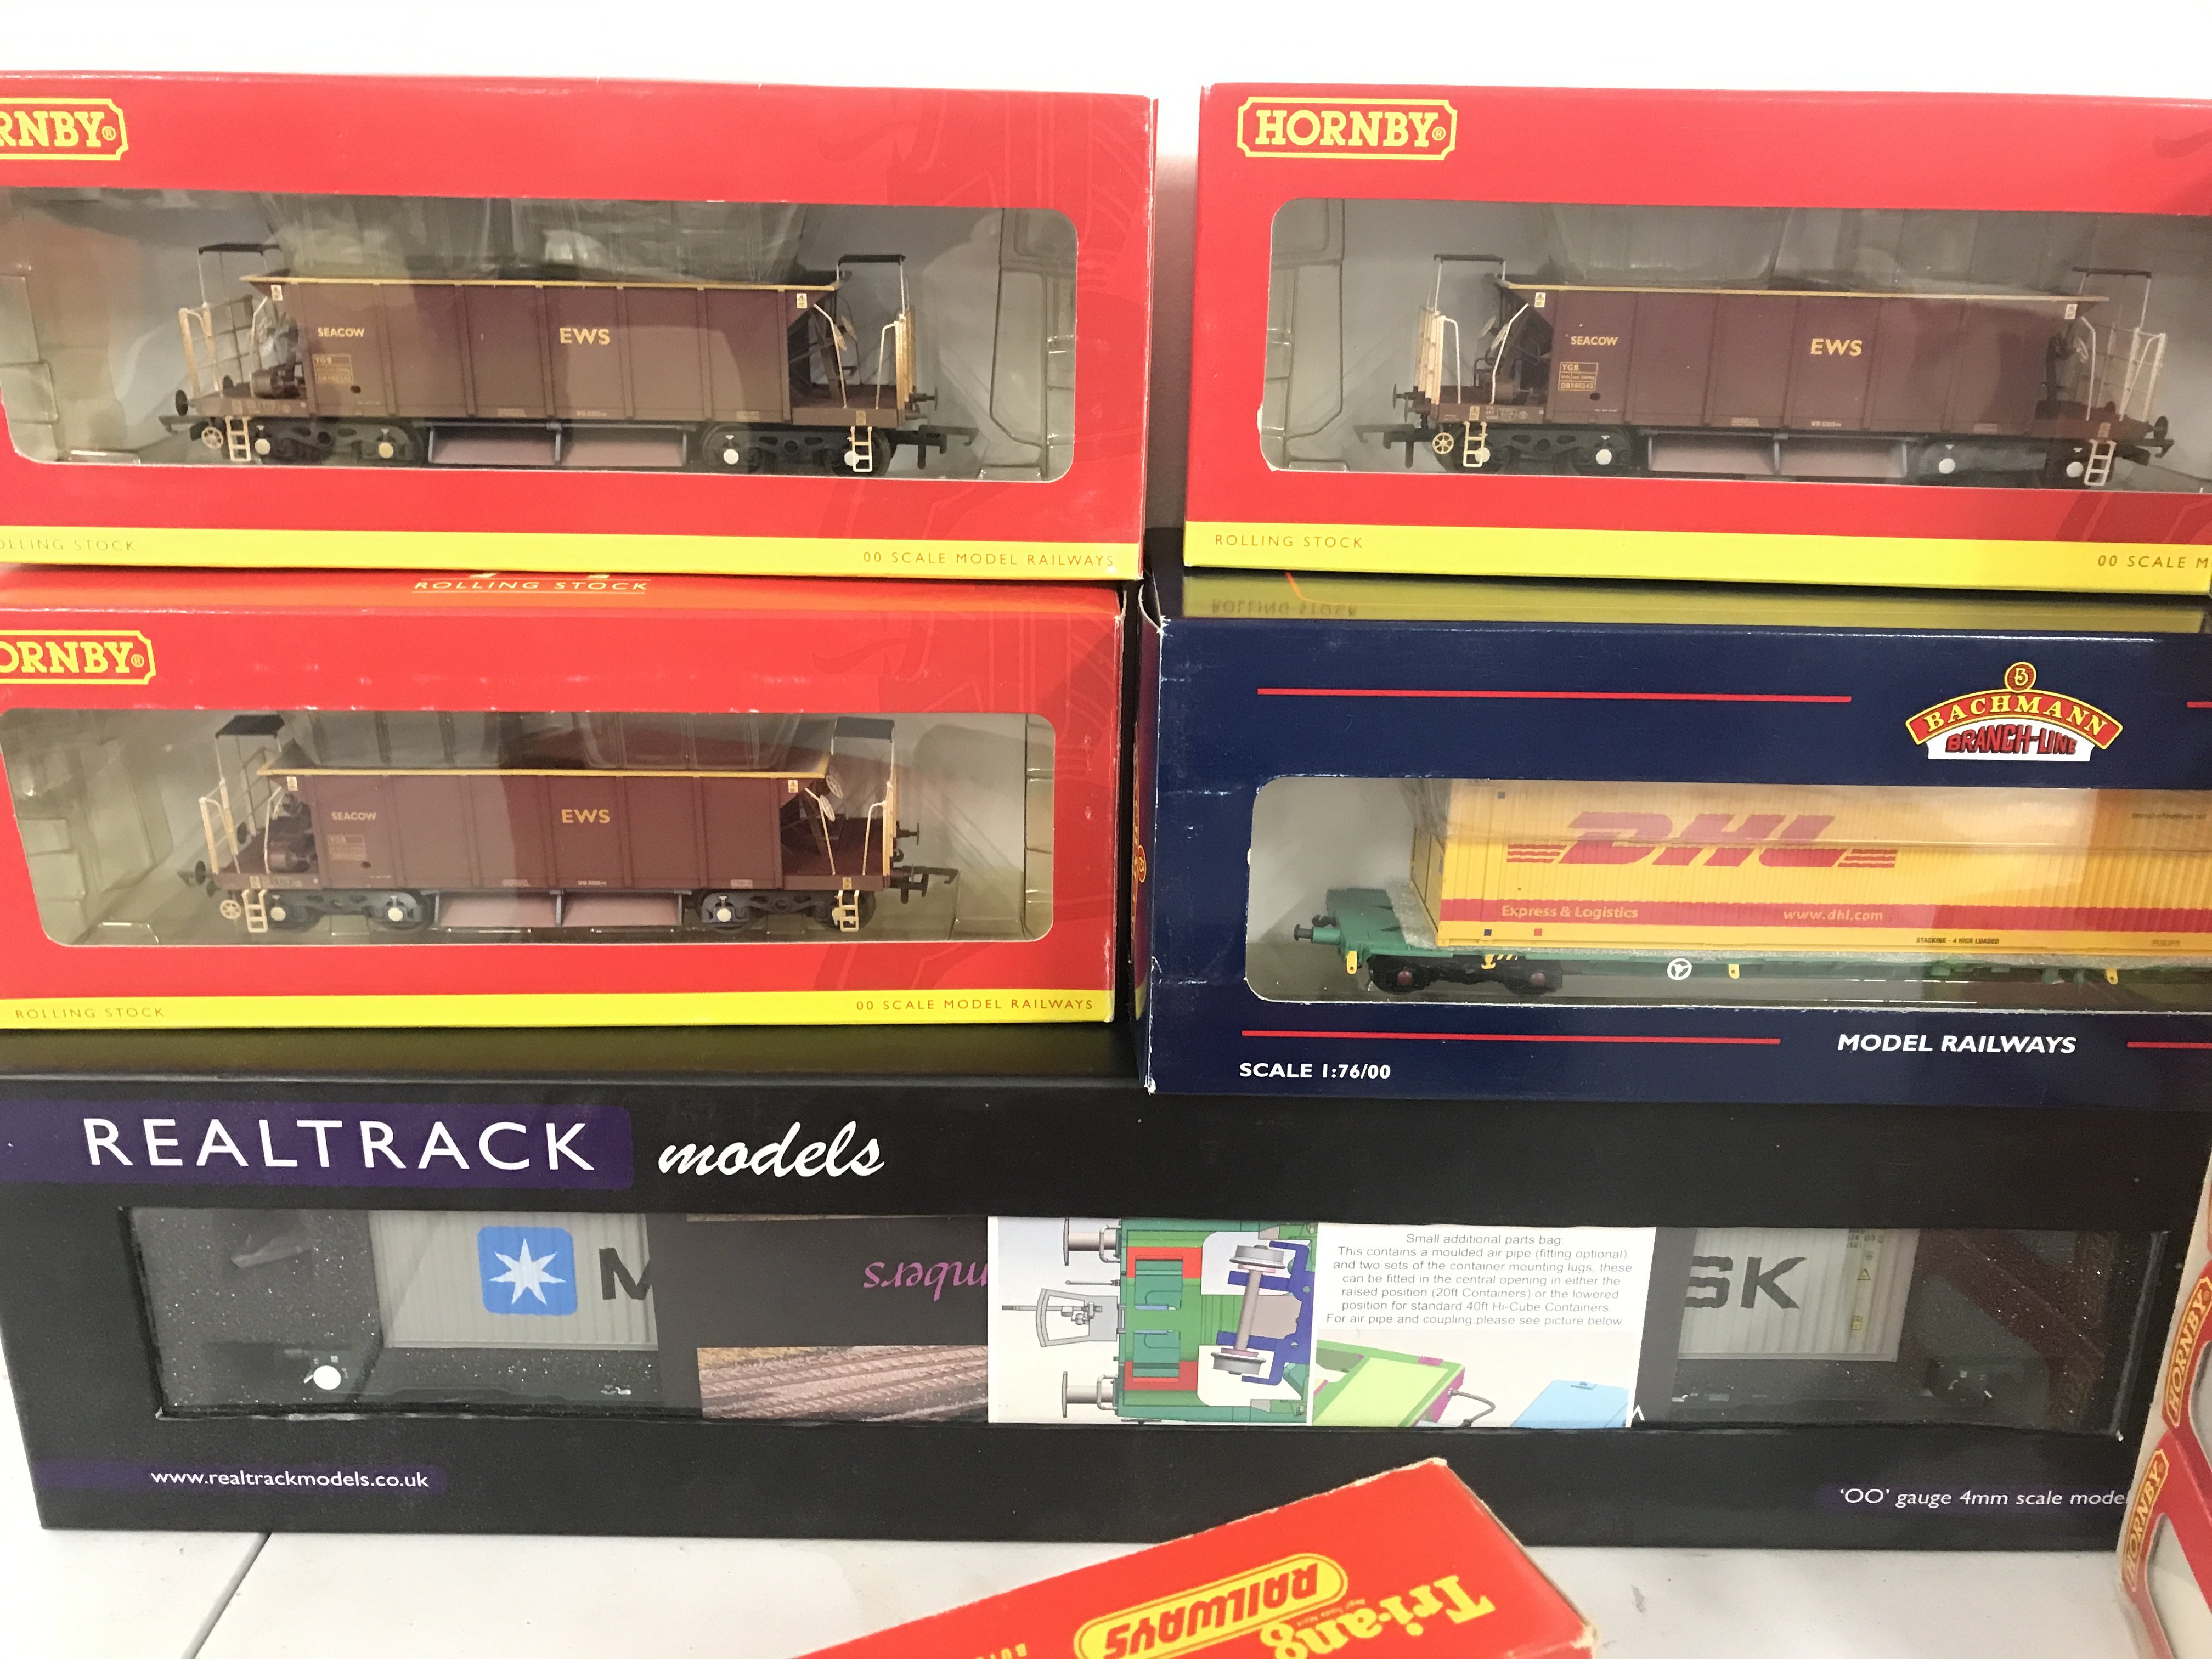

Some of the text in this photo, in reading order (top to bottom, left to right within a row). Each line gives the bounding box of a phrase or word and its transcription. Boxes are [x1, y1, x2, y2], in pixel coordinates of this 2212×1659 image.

[318, 328, 364, 337] SEACOW
[560, 328, 610, 345] EWS
[1571, 336, 1618, 345] SEACOW
[1810, 338, 1862, 356] EWS
[74, 540, 136, 551] STOCK
[1215, 534, 1362, 548] ROLLING STOCK
[891, 552, 946, 564] SCALE
[956, 553, 1017, 565] MODEL
[1028, 555, 1114, 567] RAILWAYS
[2127, 556, 2186, 568] SCALE
[1923, 695, 2108, 736] BACHMANN
[1945, 724, 2078, 755] BRANCH-LINE
[331, 812, 376, 820] SEACOW
[561, 809, 611, 823] EWS
[1558, 811, 1848, 867] DHL
[1502, 905, 1639, 920] Express & Logistics
[1784, 909, 1883, 921] www.dhl.com
[883, 1000, 934, 1010] SCALE
[944, 1000, 1002, 1009] MODEL
[1012, 999, 1093, 1009] RAILWAYS
[15, 1008, 165, 1019] ROLLING STOCK
[1837, 1034, 2077, 1053] MODEL RAILWAYS
[1240, 1063, 1391, 1079] SCALE 1:76/00
[83, 1118, 885, 1177] REALTRACK models
[1407, 1234, 1439, 1243] Small
[1443, 1234, 1501, 1244] additional
[1505, 1236, 1534, 1245] parts
[1339, 1246, 1362, 1256] This
[1367, 1248, 1417, 1256] contains
[1432, 1248, 1483, 1257] moulded
[1487, 1249, 1502, 1257] air
[1506, 1249, 1531, 1259] pipe
[1536, 1249, 1571, 1260] (fitting
[1576, 1250, 1628, 1260] optional)
[1333, 1261, 1355, 1269] and
[1360, 1261, 1380, 1269] two
[1385, 1261, 1408, 1269] sets
[1412, 1261, 1424, 1270] of
[1427, 1261, 1446, 1270] the
[1450, 1262, 1505, 1271] container
[1509, 1263, 1564, 1274] mounting
[1600, 1263, 1633, 1272] these
[1368, 1274, 1383, 1283] be
[1387, 1274, 1415, 1283] fitted
[1420, 1274, 1429, 1283] in
[1434, 1274, 1452, 1284] the
[1455, 1275, 1496, 1284] central
[1499, 1276, 1547, 1287] opening
[1551, 1277, 1561, 1285] in
[1565, 1276, 1599, 1285] either
[1602, 1277, 1621, 1285] the
[1342, 1287, 1378, 1296] raised
[1381, 1288, 1427, 1299] position
[1432, 1288, 1458, 1299] (20ft
[1463, 1288, 1531, 1300] Containers)
[1550, 1290, 1568, 1299] the
[1573, 1290, 1619, 1299] lowered
[1342, 1301, 1387, 1311] position
[1391, 1301, 1407, 1310] for
[1411, 1301, 1462, 1311] standard
[1466, 1302, 1488, 1311] 40ft
[1493, 1302, 1541, 1312] Hi-Cube
[1327, 1314, 1346, 1323] For
[1350, 1315, 1364, 1323] air
[1369, 1315, 1393, 1325] pipe
[1397, 1315, 1419, 1324] and
[1519, 1317, 1541, 1325] see
[1544, 1317, 1584, 1327] picture
[151, 1470, 430, 1487] www.realtrackmodels.co.uk
[1895, 1493, 1952, 1509] gauge
[1959, 1490, 2007, 1505] 4mm
[2016, 1490, 2063, 1505] scale
[1104, 1563, 1317, 1658] RAILWAYS
